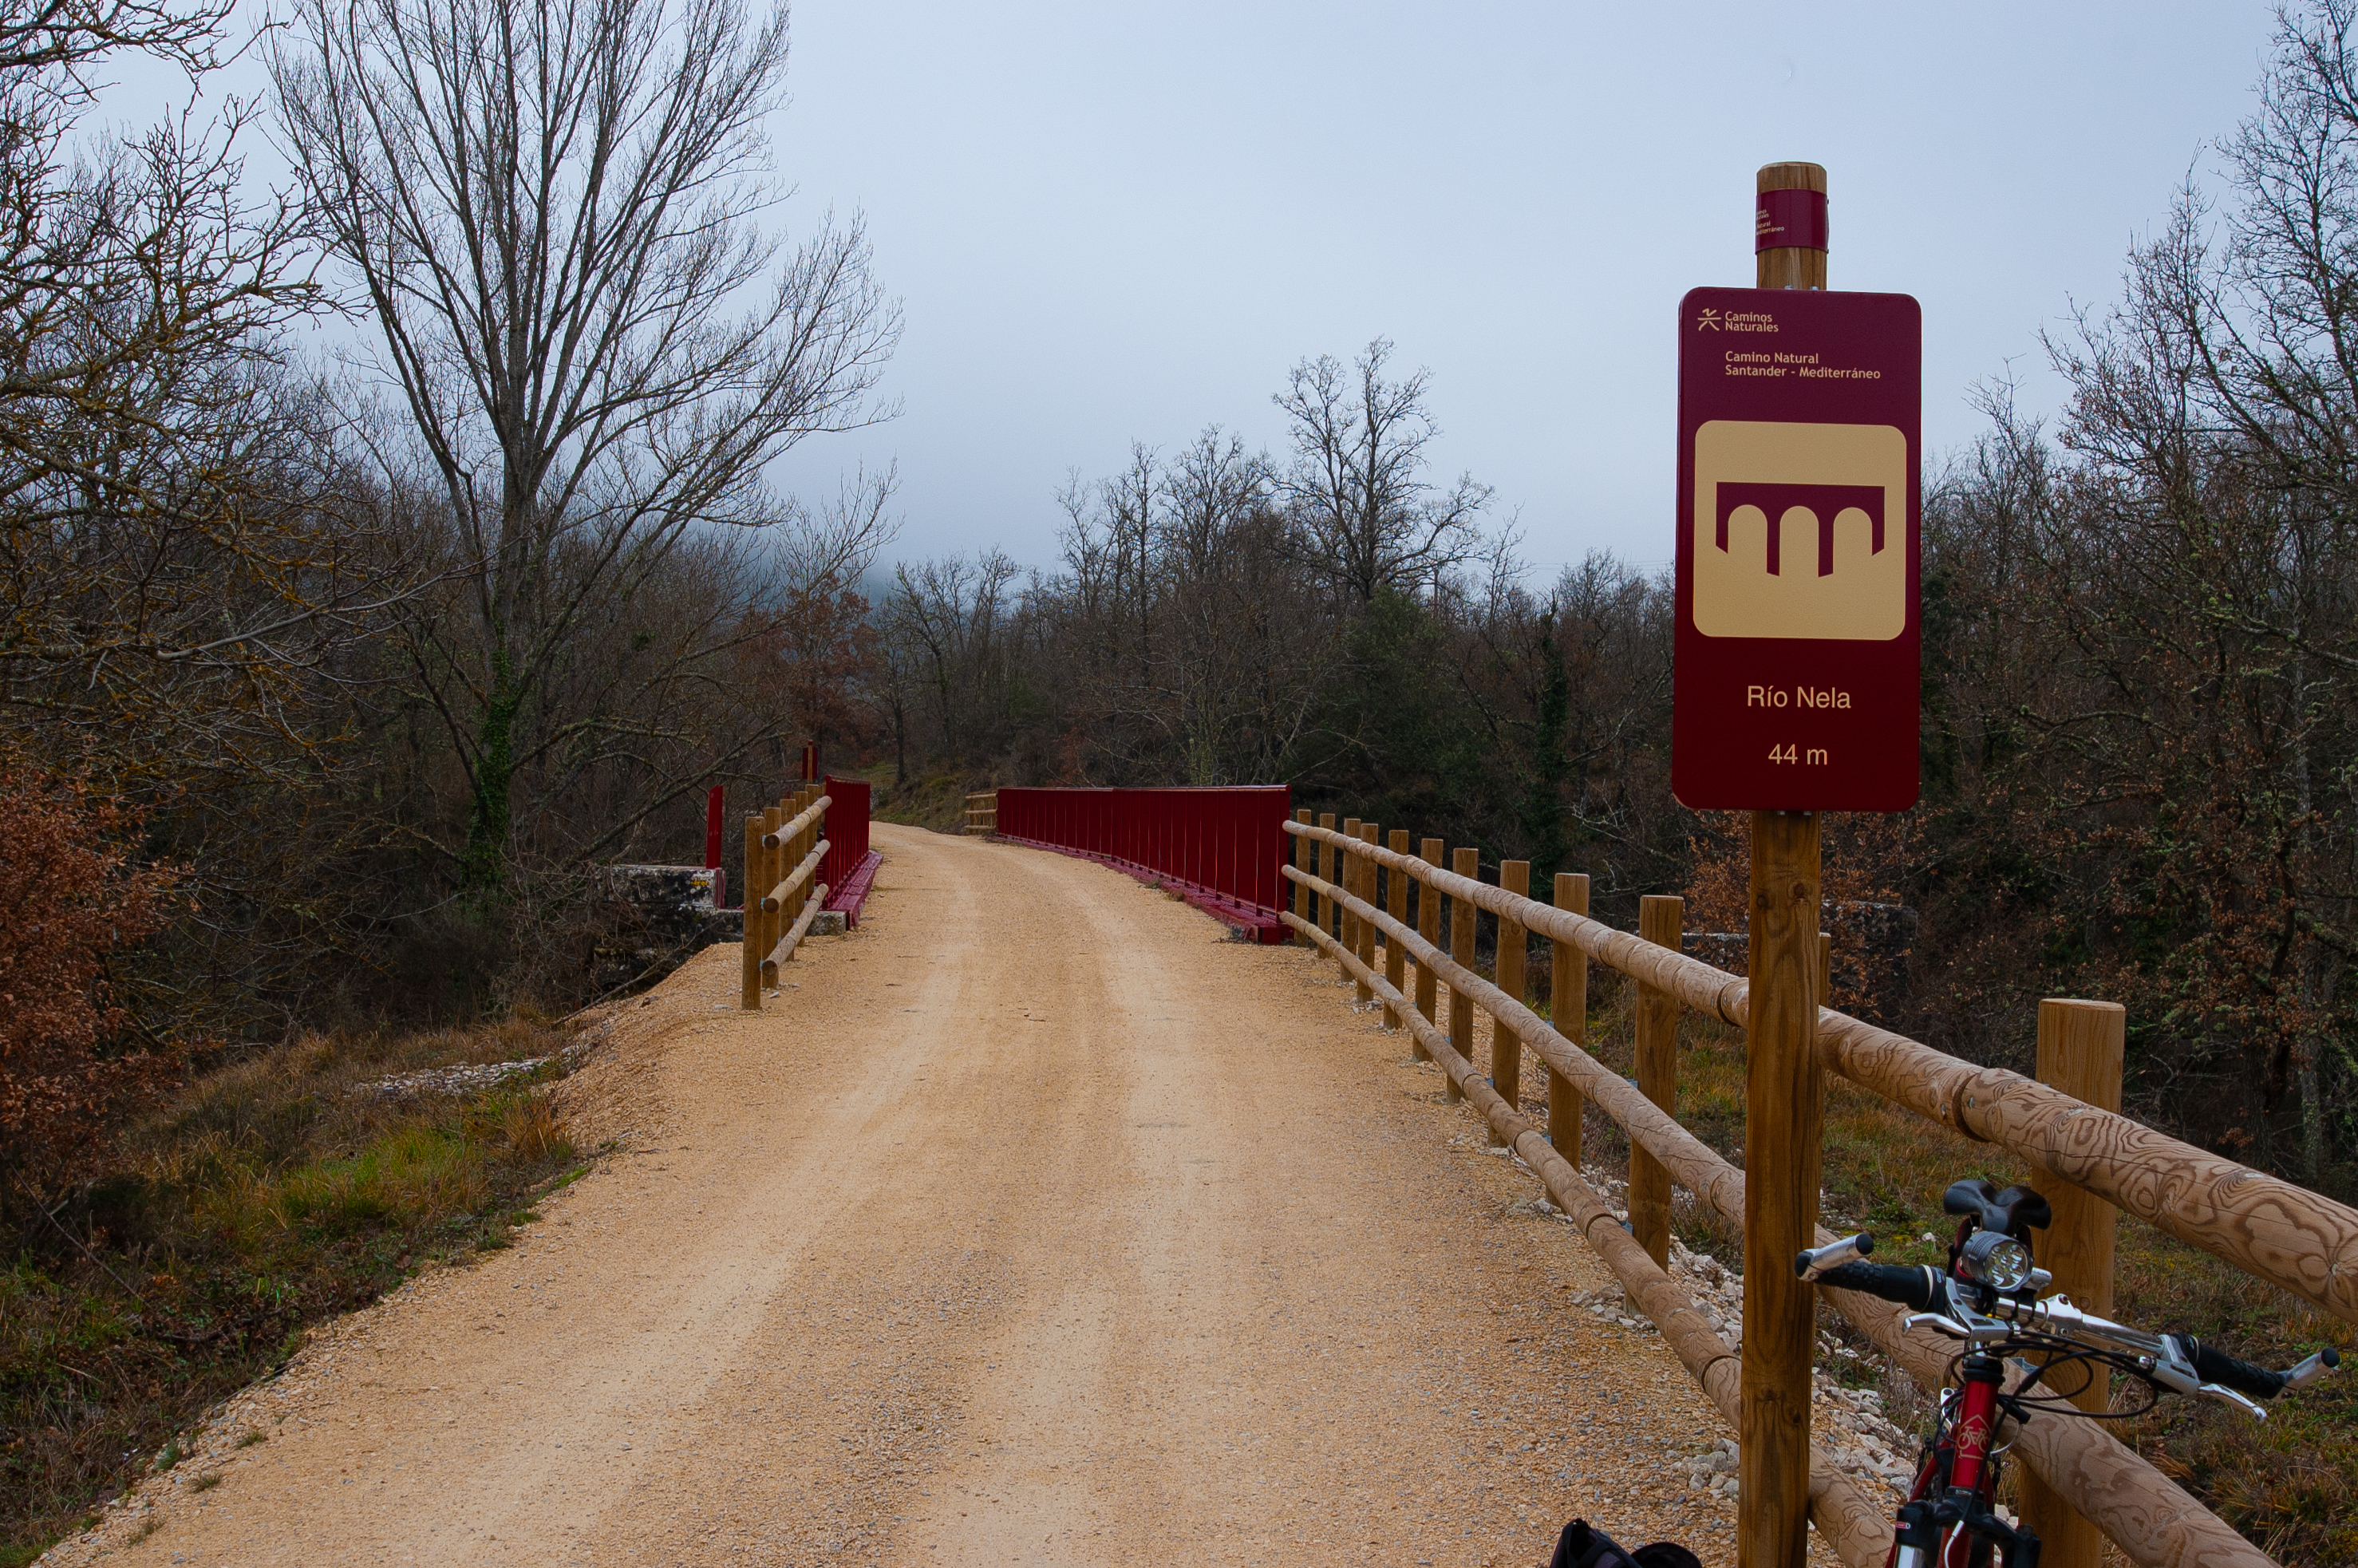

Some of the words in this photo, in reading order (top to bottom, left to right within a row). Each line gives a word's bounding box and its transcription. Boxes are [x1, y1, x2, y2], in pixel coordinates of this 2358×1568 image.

[1725, 311, 1772, 322] Caminos
[1725, 322, 1779, 332] Naturales
[1725, 350, 1771, 362] Camino
[1774, 352, 1819, 364] Natural
[1725, 364, 1787, 377] Santander
[1799, 366, 1881, 379] Mediterráneo
[1748, 685, 1788, 708] Río
[1797, 686, 1851, 709] Nela
[1768, 744, 1798, 765] 44
[1807, 748, 1827, 766] m
